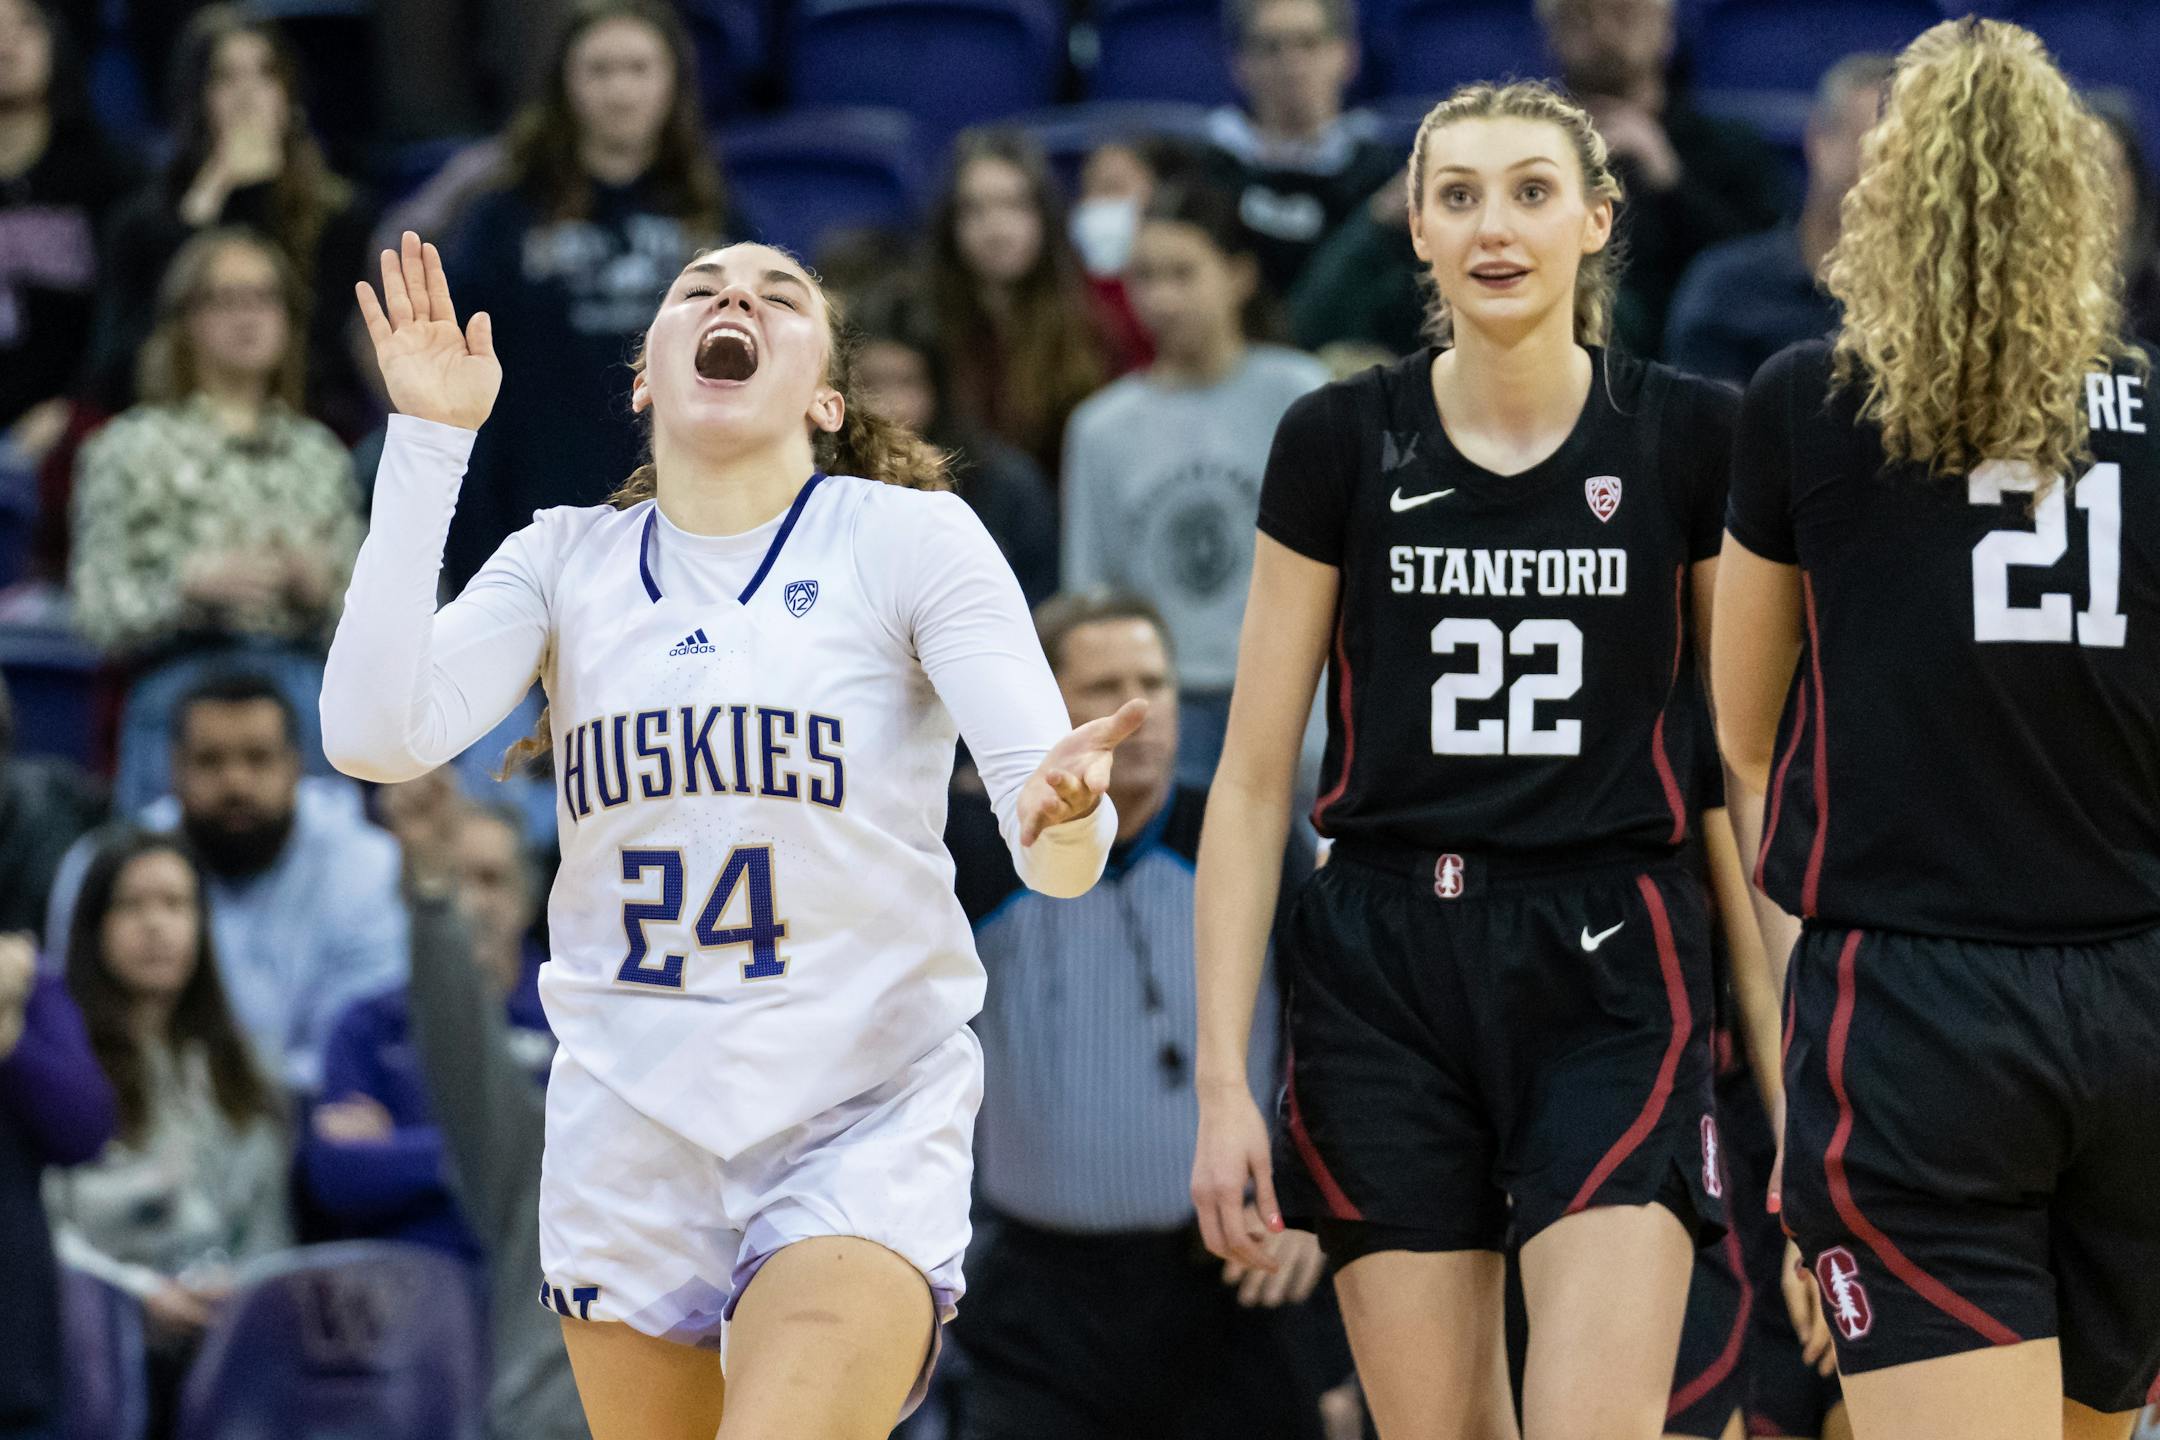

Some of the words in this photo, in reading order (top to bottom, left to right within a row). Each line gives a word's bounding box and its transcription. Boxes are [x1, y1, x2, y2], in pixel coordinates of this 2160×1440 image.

[786, 581, 817, 603] PAC
[1389, 545, 1628, 597] STANFORD
[1967, 458, 2128, 648] 21
[792, 598, 809, 611] 12
[669, 643, 716, 657] adidas
[1430, 617, 1584, 756] 22
[563, 702, 846, 824] HUSKIES
[612, 842, 792, 992] 24
